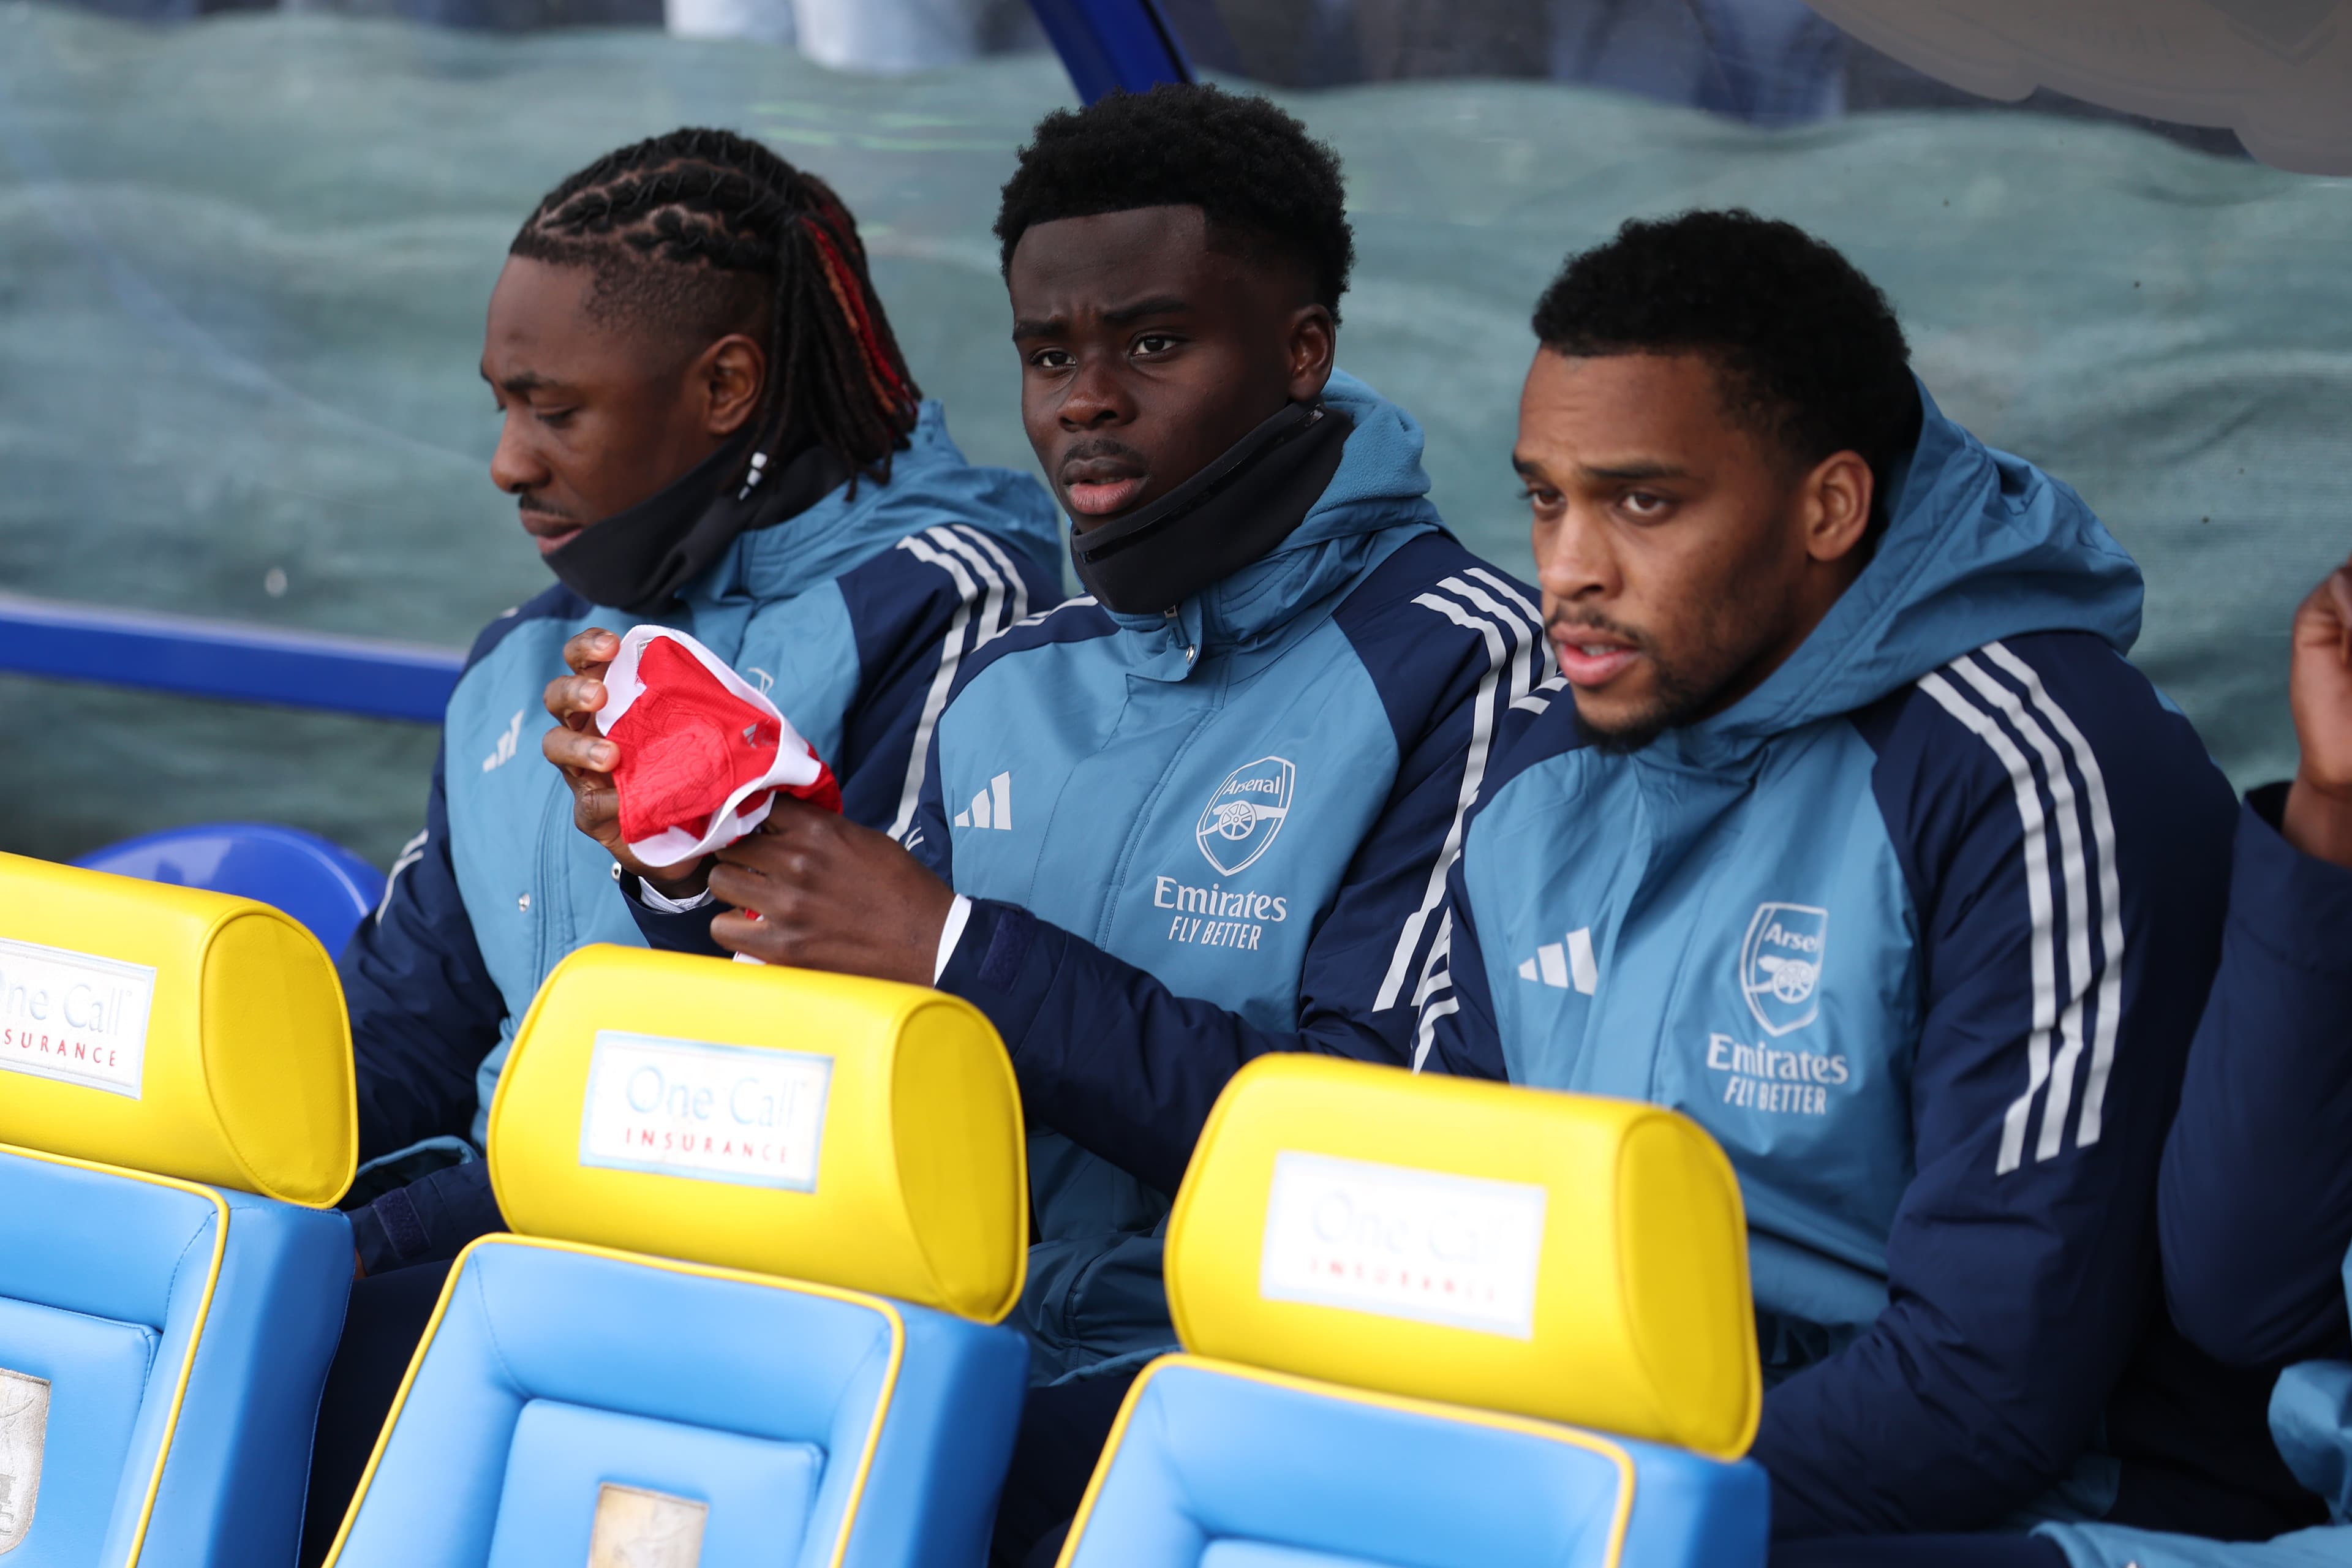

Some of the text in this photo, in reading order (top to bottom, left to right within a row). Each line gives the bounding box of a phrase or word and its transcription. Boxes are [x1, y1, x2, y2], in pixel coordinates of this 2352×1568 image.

[1223, 776, 1280, 794] Arsenal
[1154, 875, 1287, 922] Emirates
[1169, 916, 1262, 951] FLY BETTER
[0, 970, 123, 1036] ne Call
[1706, 1032, 1849, 1085] Emirates
[627, 1065, 797, 1128] One Call
[1724, 1076, 1827, 1115] FLY BETTER
[626, 1128, 786, 1163] INSURANCE
